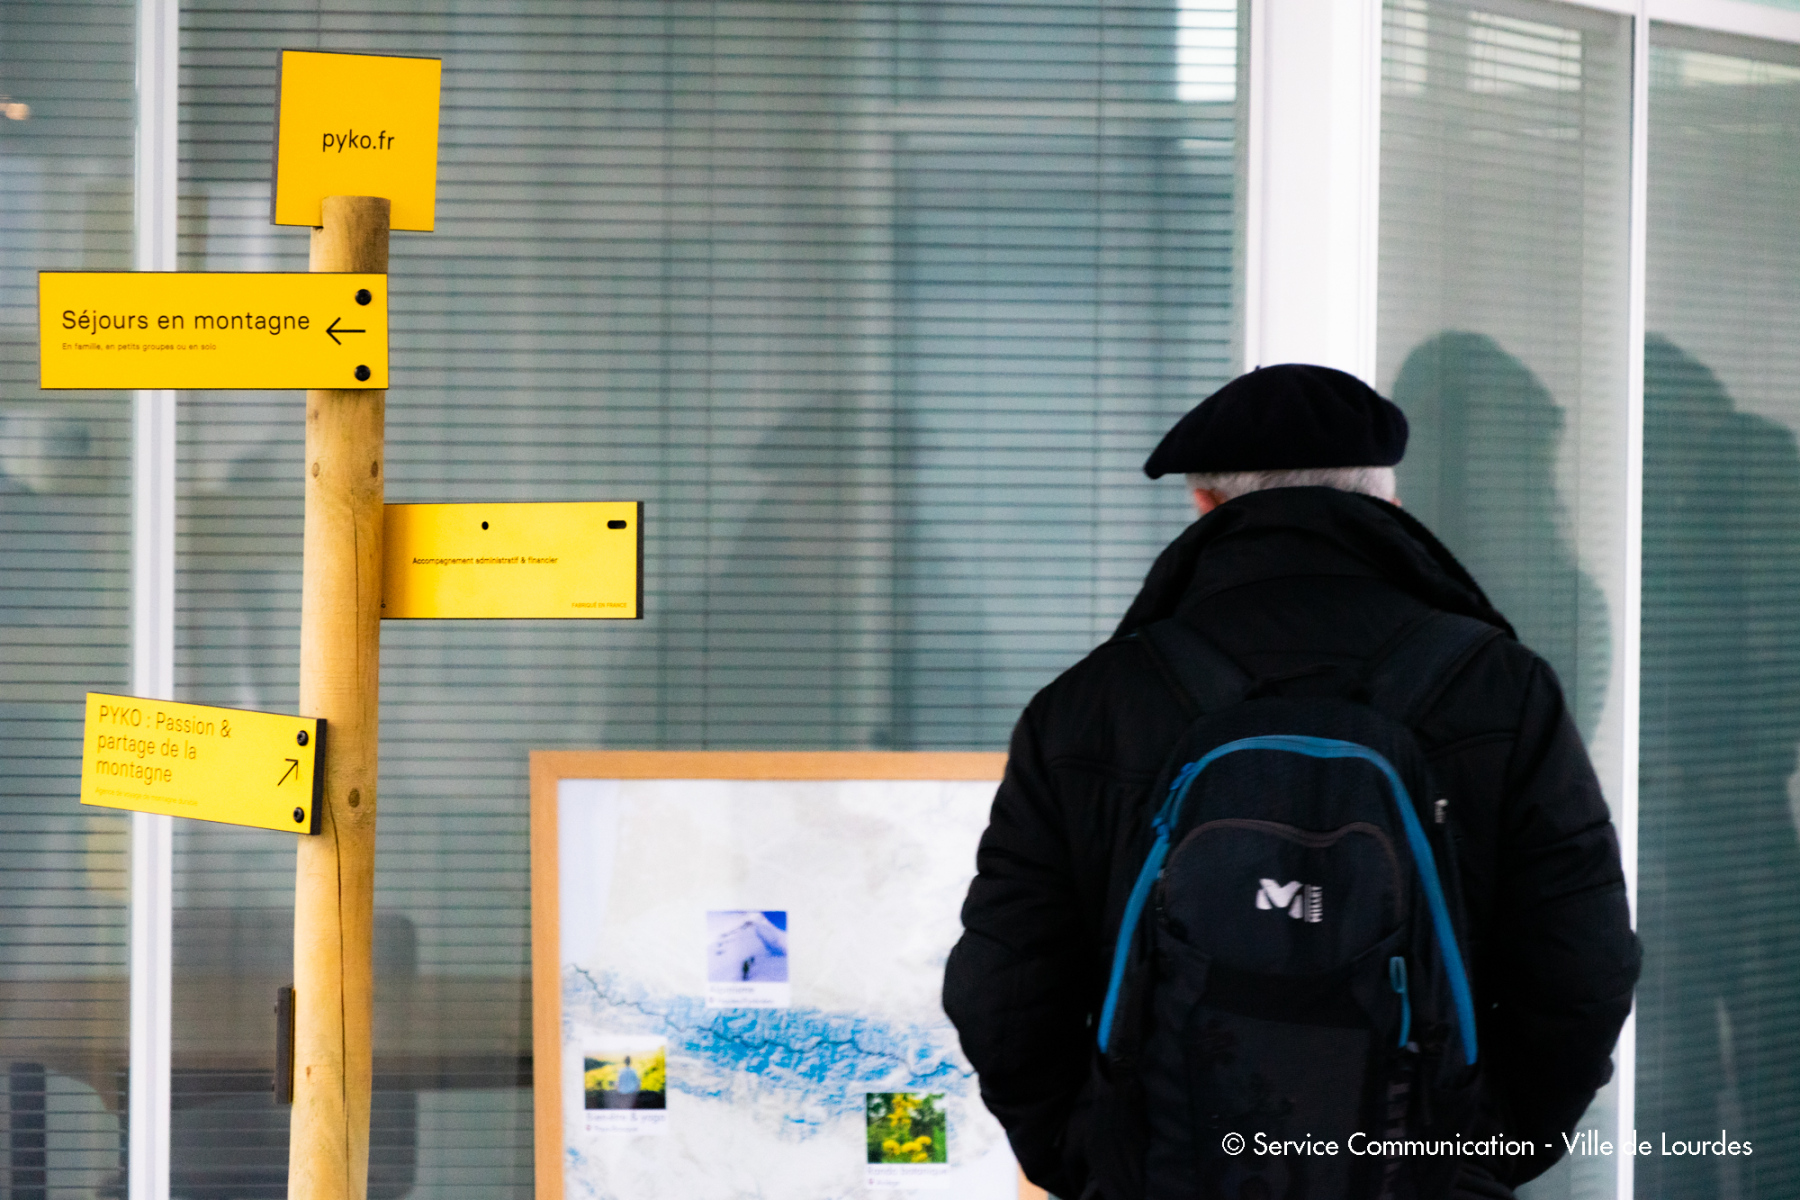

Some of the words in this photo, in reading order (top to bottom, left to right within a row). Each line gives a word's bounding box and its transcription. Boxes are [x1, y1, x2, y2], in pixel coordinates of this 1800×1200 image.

[322, 128, 395, 153] pyko.fr
[62, 310, 149, 335] Séjours
[157, 315, 184, 330] en
[194, 312, 310, 335] montagne
[62, 342, 72, 350] En
[75, 342, 103, 351] famille,
[117, 343, 140, 352] petits
[142, 344, 174, 352] groupes
[412, 557, 473, 566] Accompagnement
[475, 556, 519, 564] administratif
[528, 556, 558, 564] financier
[99, 705, 142, 727] PYKO
[146, 716, 151, 728] :
[155, 711, 215, 736] Passion
[220, 719, 232, 738] &
[97, 734, 155, 758] partage
[160, 738, 179, 757] de
[184, 740, 197, 759] la
[96, 760, 172, 785] montagne
